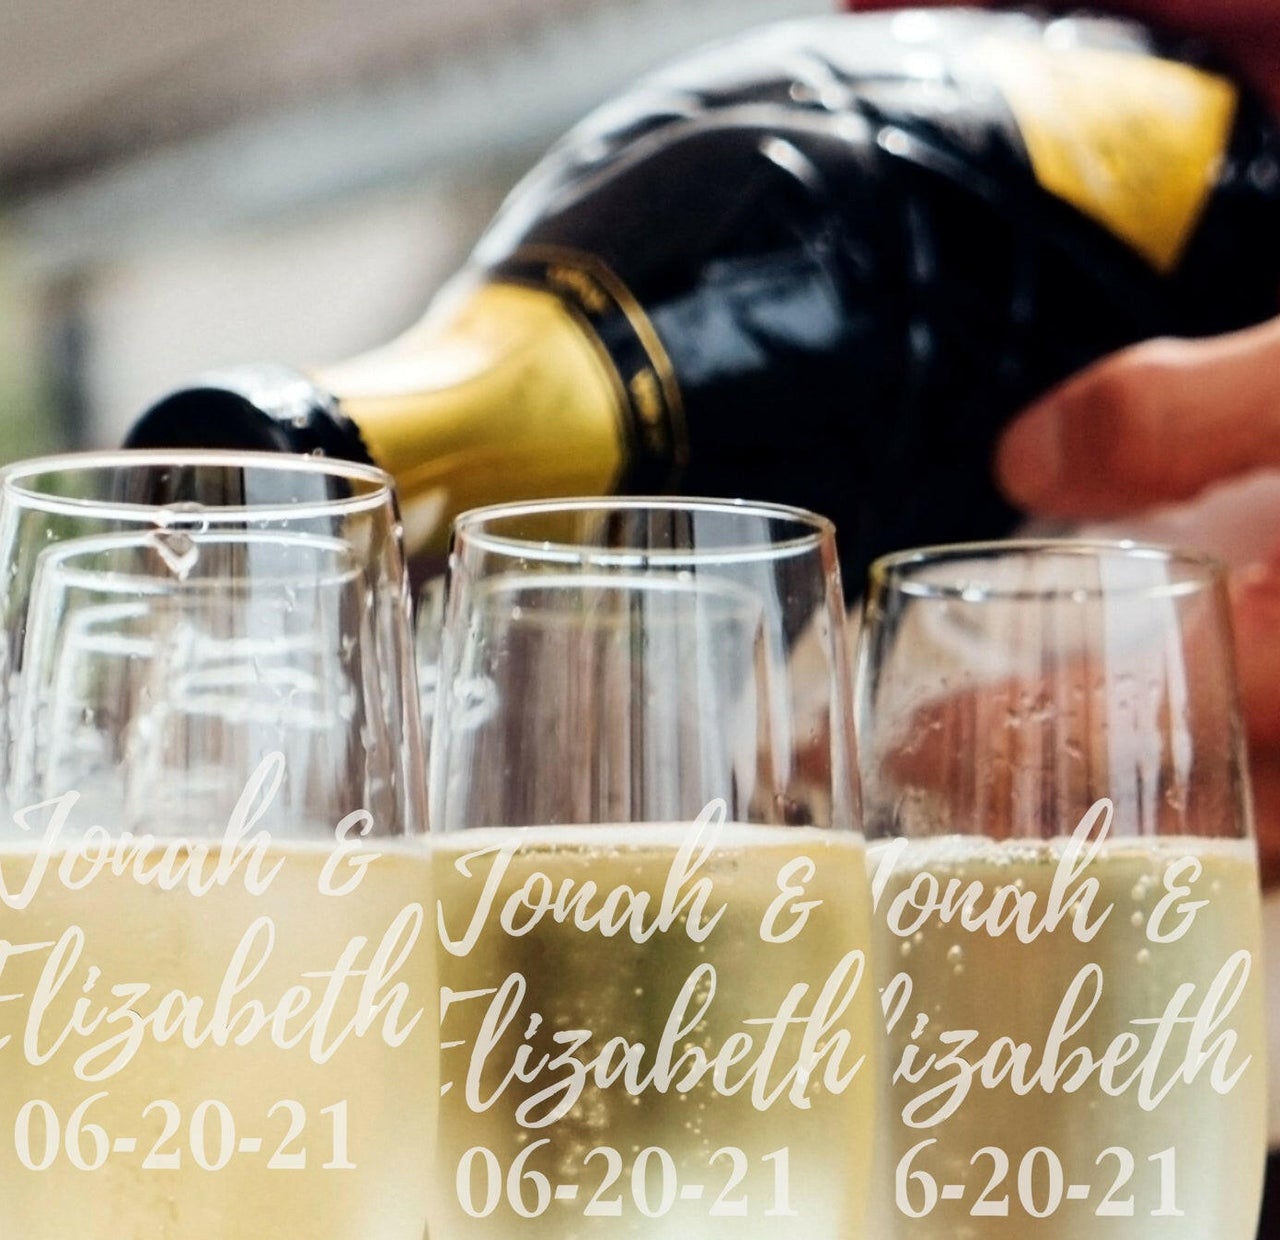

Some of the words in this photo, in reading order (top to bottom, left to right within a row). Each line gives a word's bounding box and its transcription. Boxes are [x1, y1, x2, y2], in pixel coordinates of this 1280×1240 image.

[317, 809, 382, 897] &
[436, 797, 729, 958] Jonah
[759, 855, 824, 944] &
[1145, 856, 1210, 944] &
[14, 1091, 358, 1171] 06-20-21
[455, 1137, 800, 1218] 06-20-21
[895, 1137, 1185, 1218] 6-20-21
